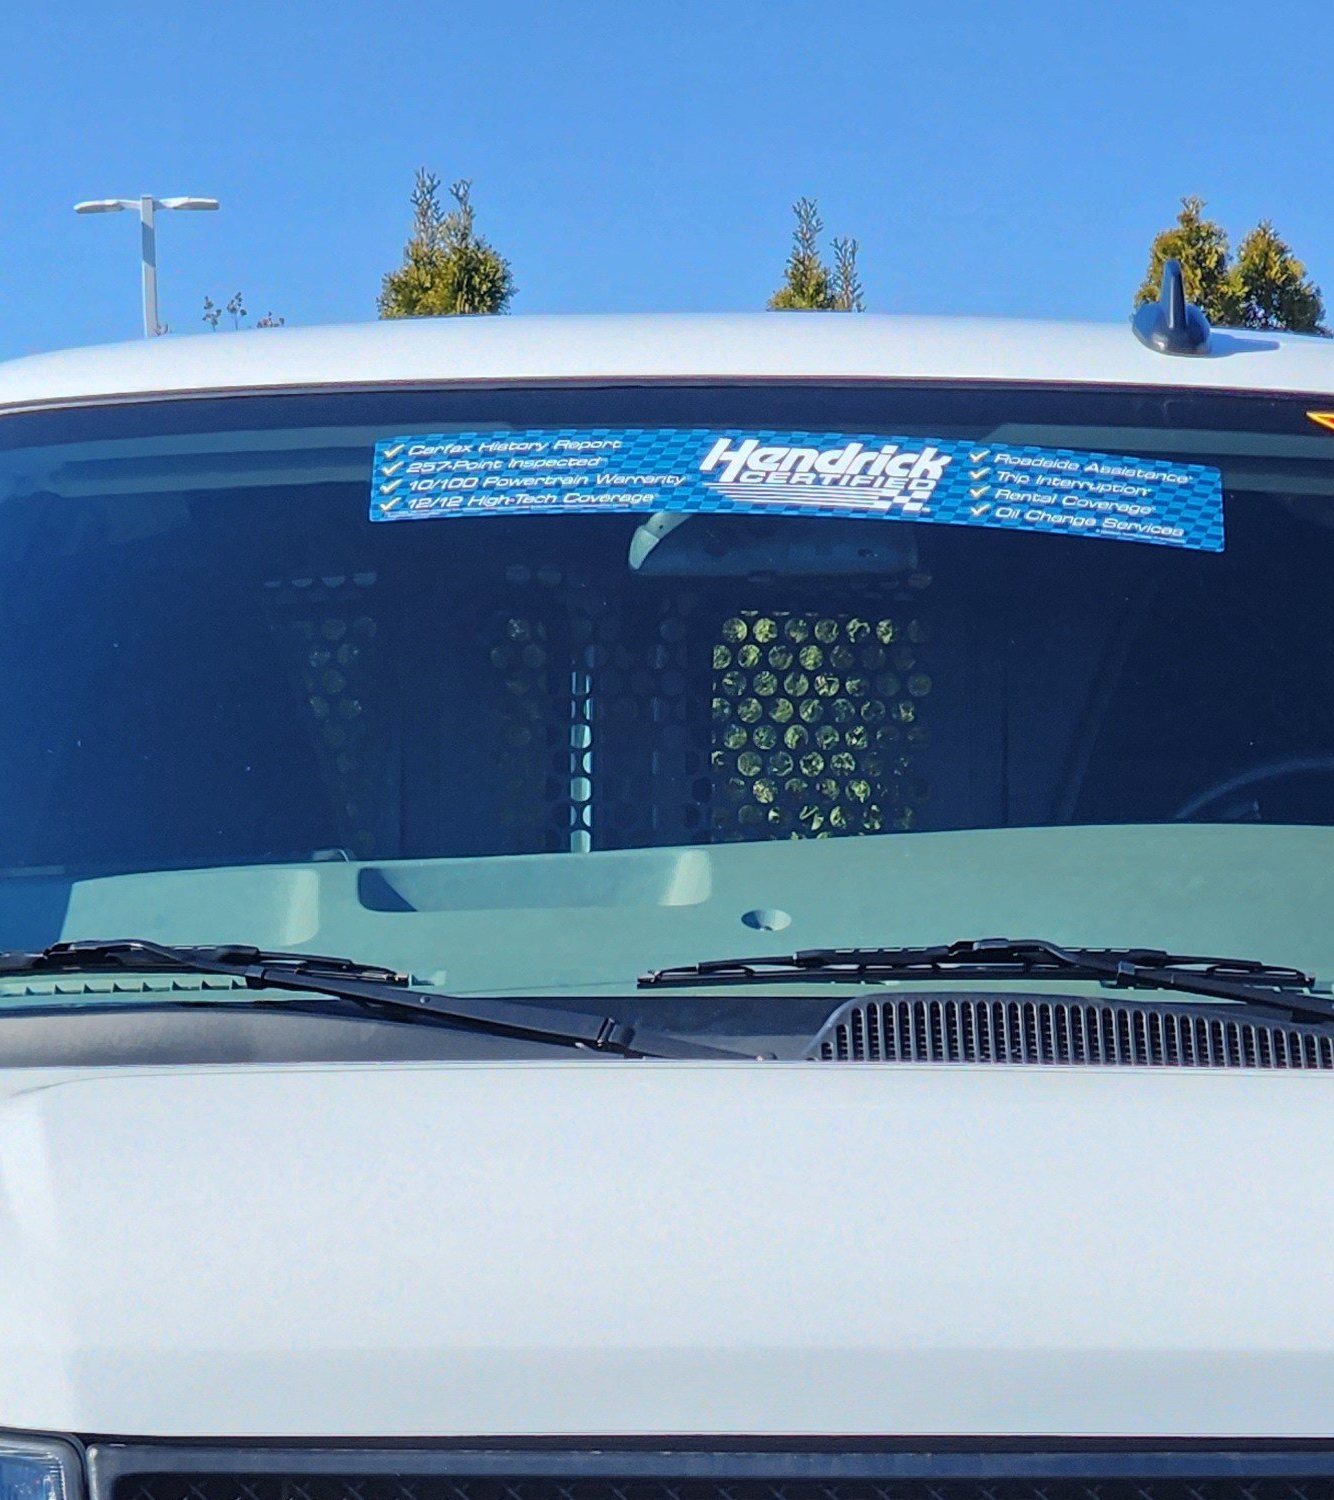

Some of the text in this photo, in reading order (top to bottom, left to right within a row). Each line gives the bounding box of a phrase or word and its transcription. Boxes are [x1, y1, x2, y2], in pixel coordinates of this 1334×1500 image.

[408, 439, 623, 456] Carfax History Report
[699, 438, 952, 482] Hendrick
[994, 453, 1080, 471] Roadside
[409, 473, 686, 491] 10/100 Powertrain Warranty
[739, 470, 937, 491] CERTIFIED
[997, 470, 1030, 485] Trip
[408, 496, 463, 510] 12/12
[468, 492, 557, 507] High-Tech
[994, 488, 1057, 504] Rental
[995, 507, 1021, 519] Oil
[1024, 509, 1097, 527] Change
[1102, 517, 1185, 537] Services
